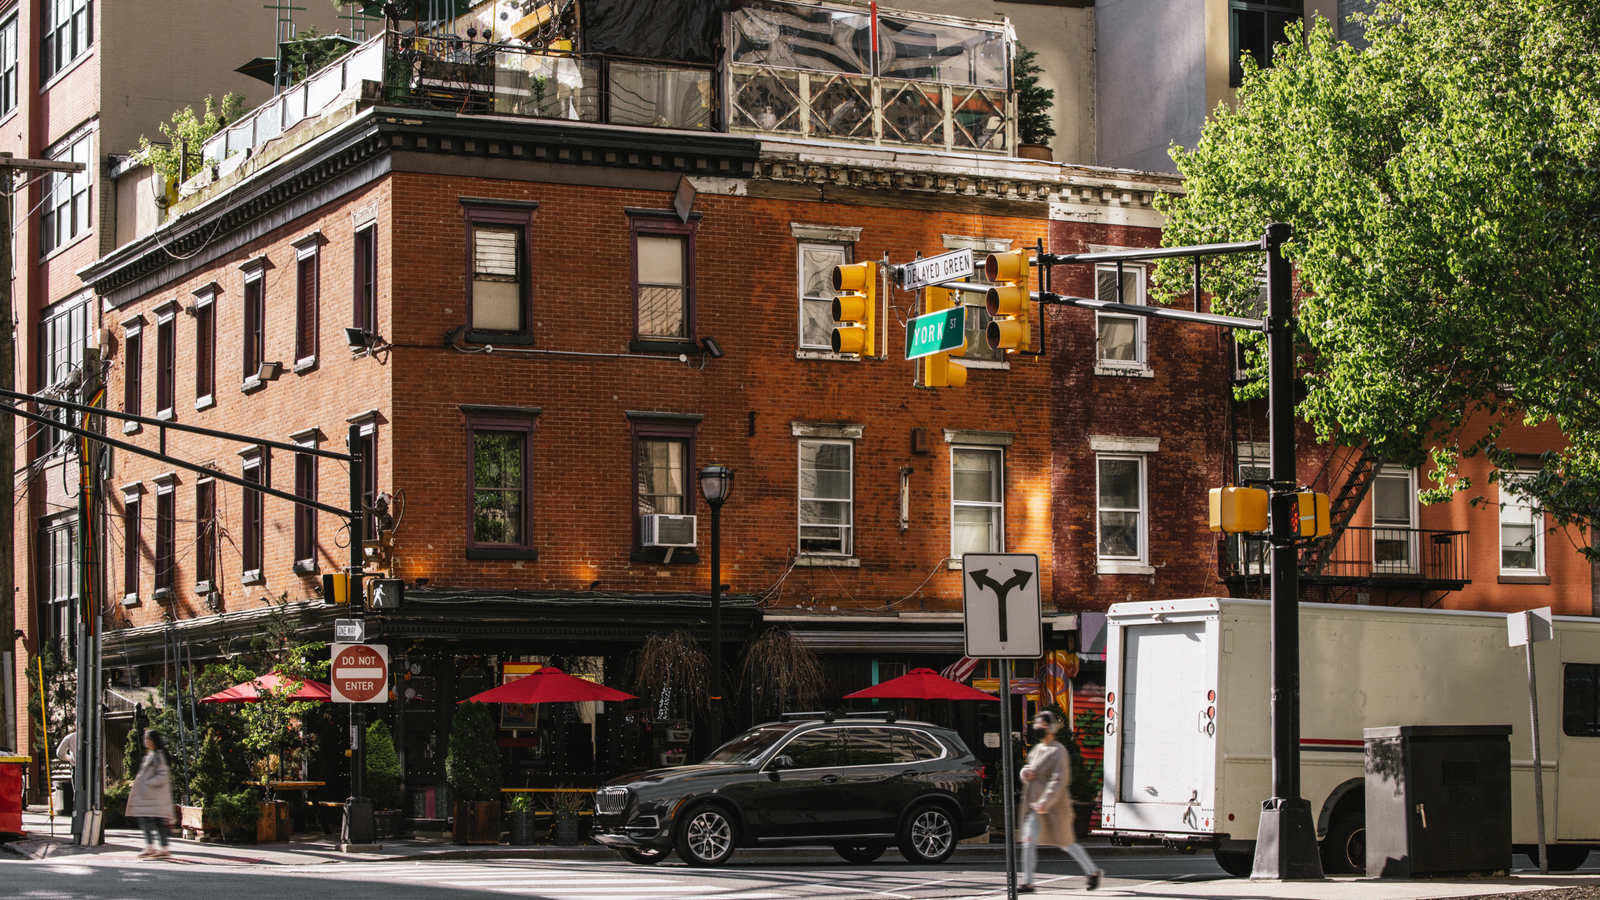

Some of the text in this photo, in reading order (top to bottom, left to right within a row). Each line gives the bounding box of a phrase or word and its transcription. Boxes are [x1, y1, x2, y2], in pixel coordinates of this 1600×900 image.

[907, 254, 970, 285] DELAYED GREEN
[914, 318, 957, 346] YORK ST
[338, 626, 357, 635] ONE WAY
[342, 656, 376, 665] DO NOT
[345, 682, 374, 691] ENTER
